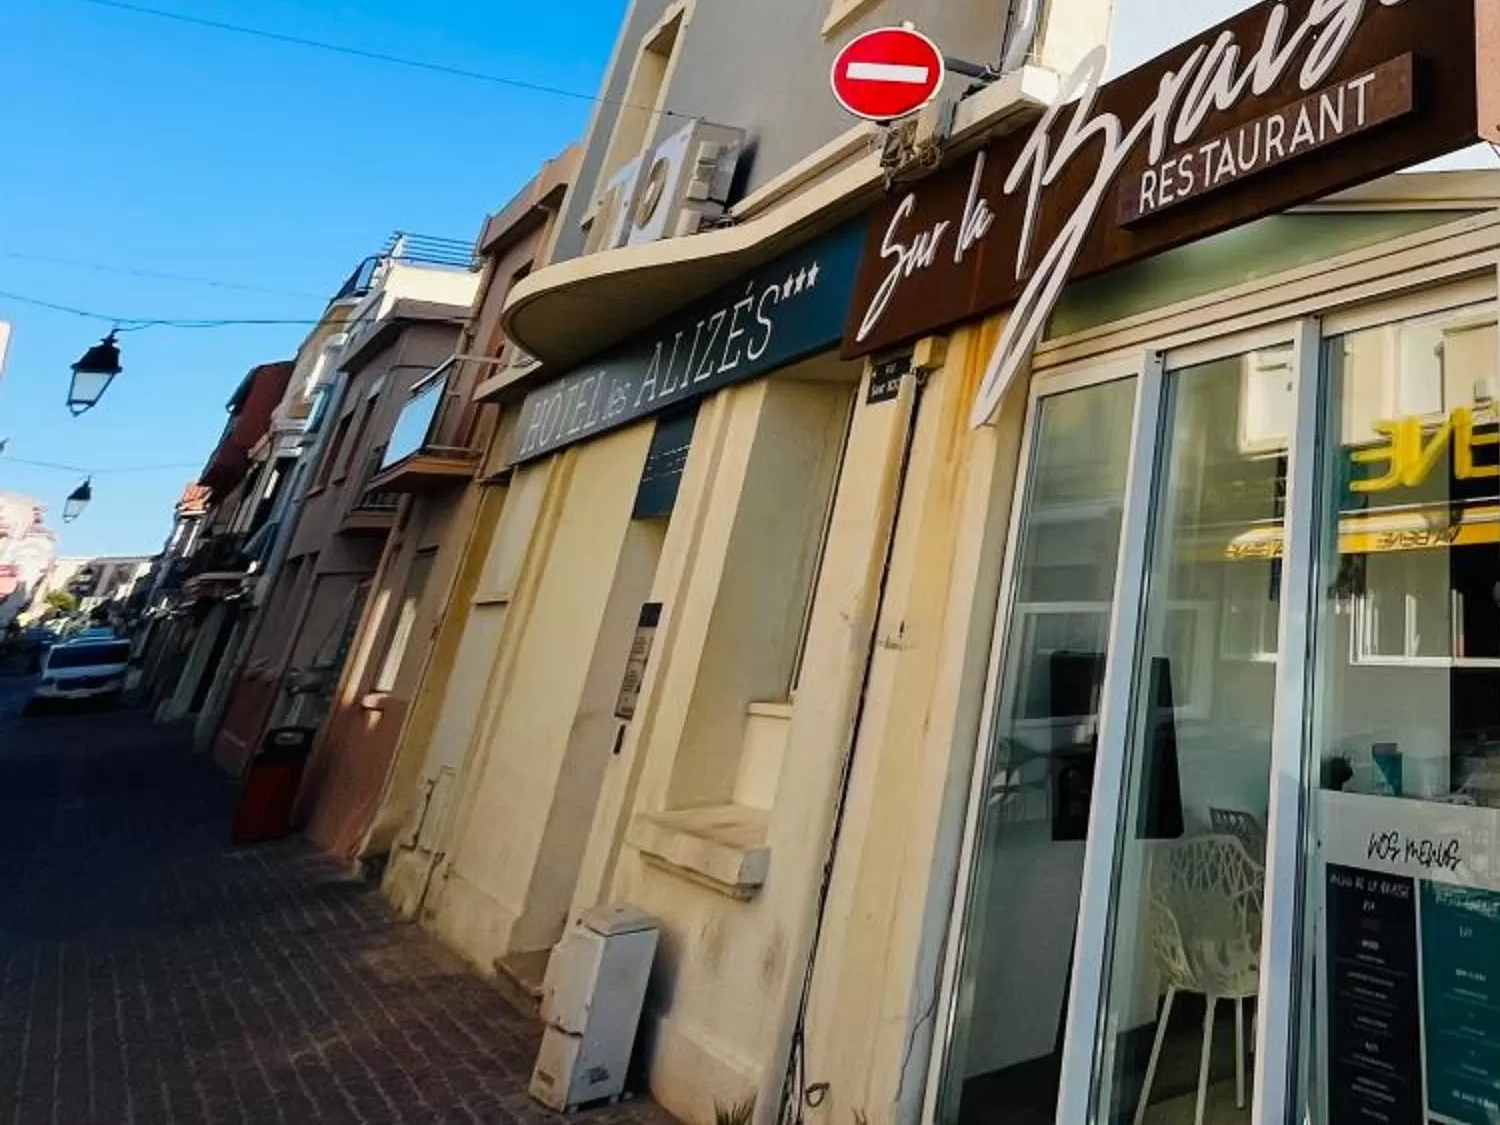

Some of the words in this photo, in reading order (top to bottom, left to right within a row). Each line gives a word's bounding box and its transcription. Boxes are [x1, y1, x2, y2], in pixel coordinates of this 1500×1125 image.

[1137, 72, 1377, 215] RESTAURANT
[857, 193, 950, 343] Sur
[954, 144, 996, 264] la
[633, 280, 781, 407] ALIZÉS
[1366, 830, 1400, 862] VOS
